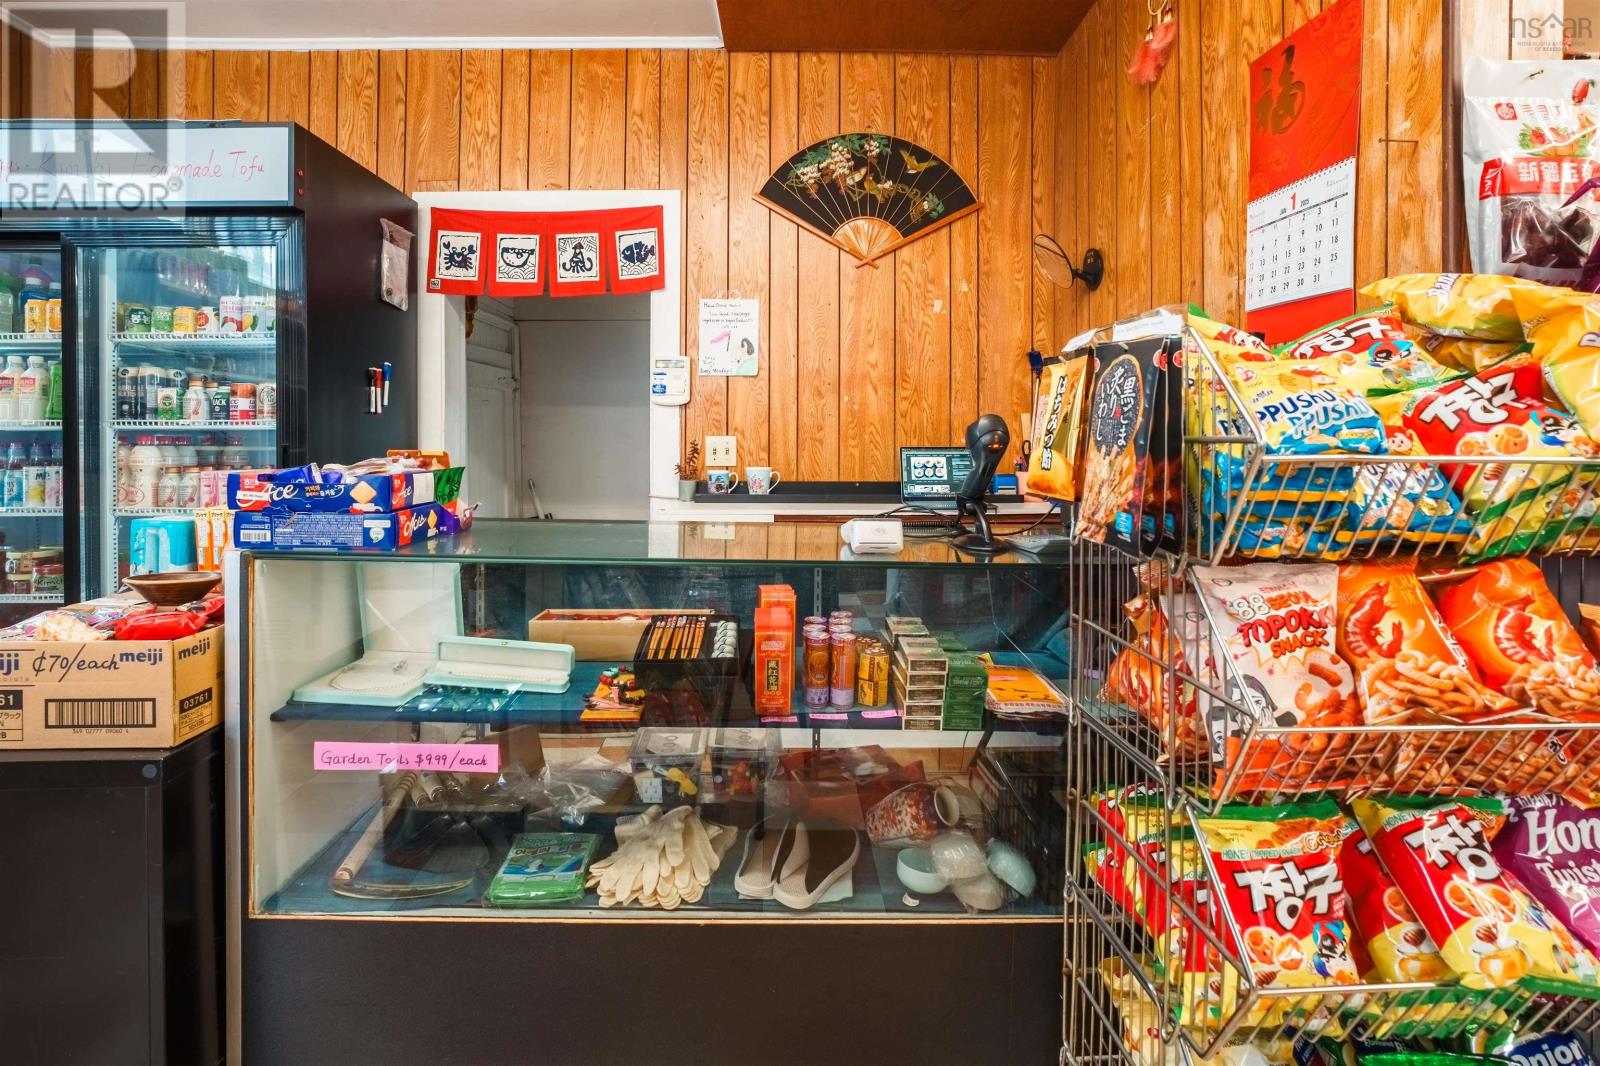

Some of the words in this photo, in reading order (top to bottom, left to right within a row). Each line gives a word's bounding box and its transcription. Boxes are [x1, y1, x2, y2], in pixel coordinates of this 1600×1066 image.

[228, 149, 265, 182] Tofu
[1290, 192, 1297, 211] 1
[392, 480, 412, 504] Ace
[1232, 593, 1271, 621] 88
[178, 637, 211, 660] meiji
[1270, 630, 1330, 659] SNACK
[119, 648, 163, 666] meiji
[183, 691, 210, 710] 03761
[320, 750, 372, 765] Garden
[1233, 860, 1343, 931] 짱구
